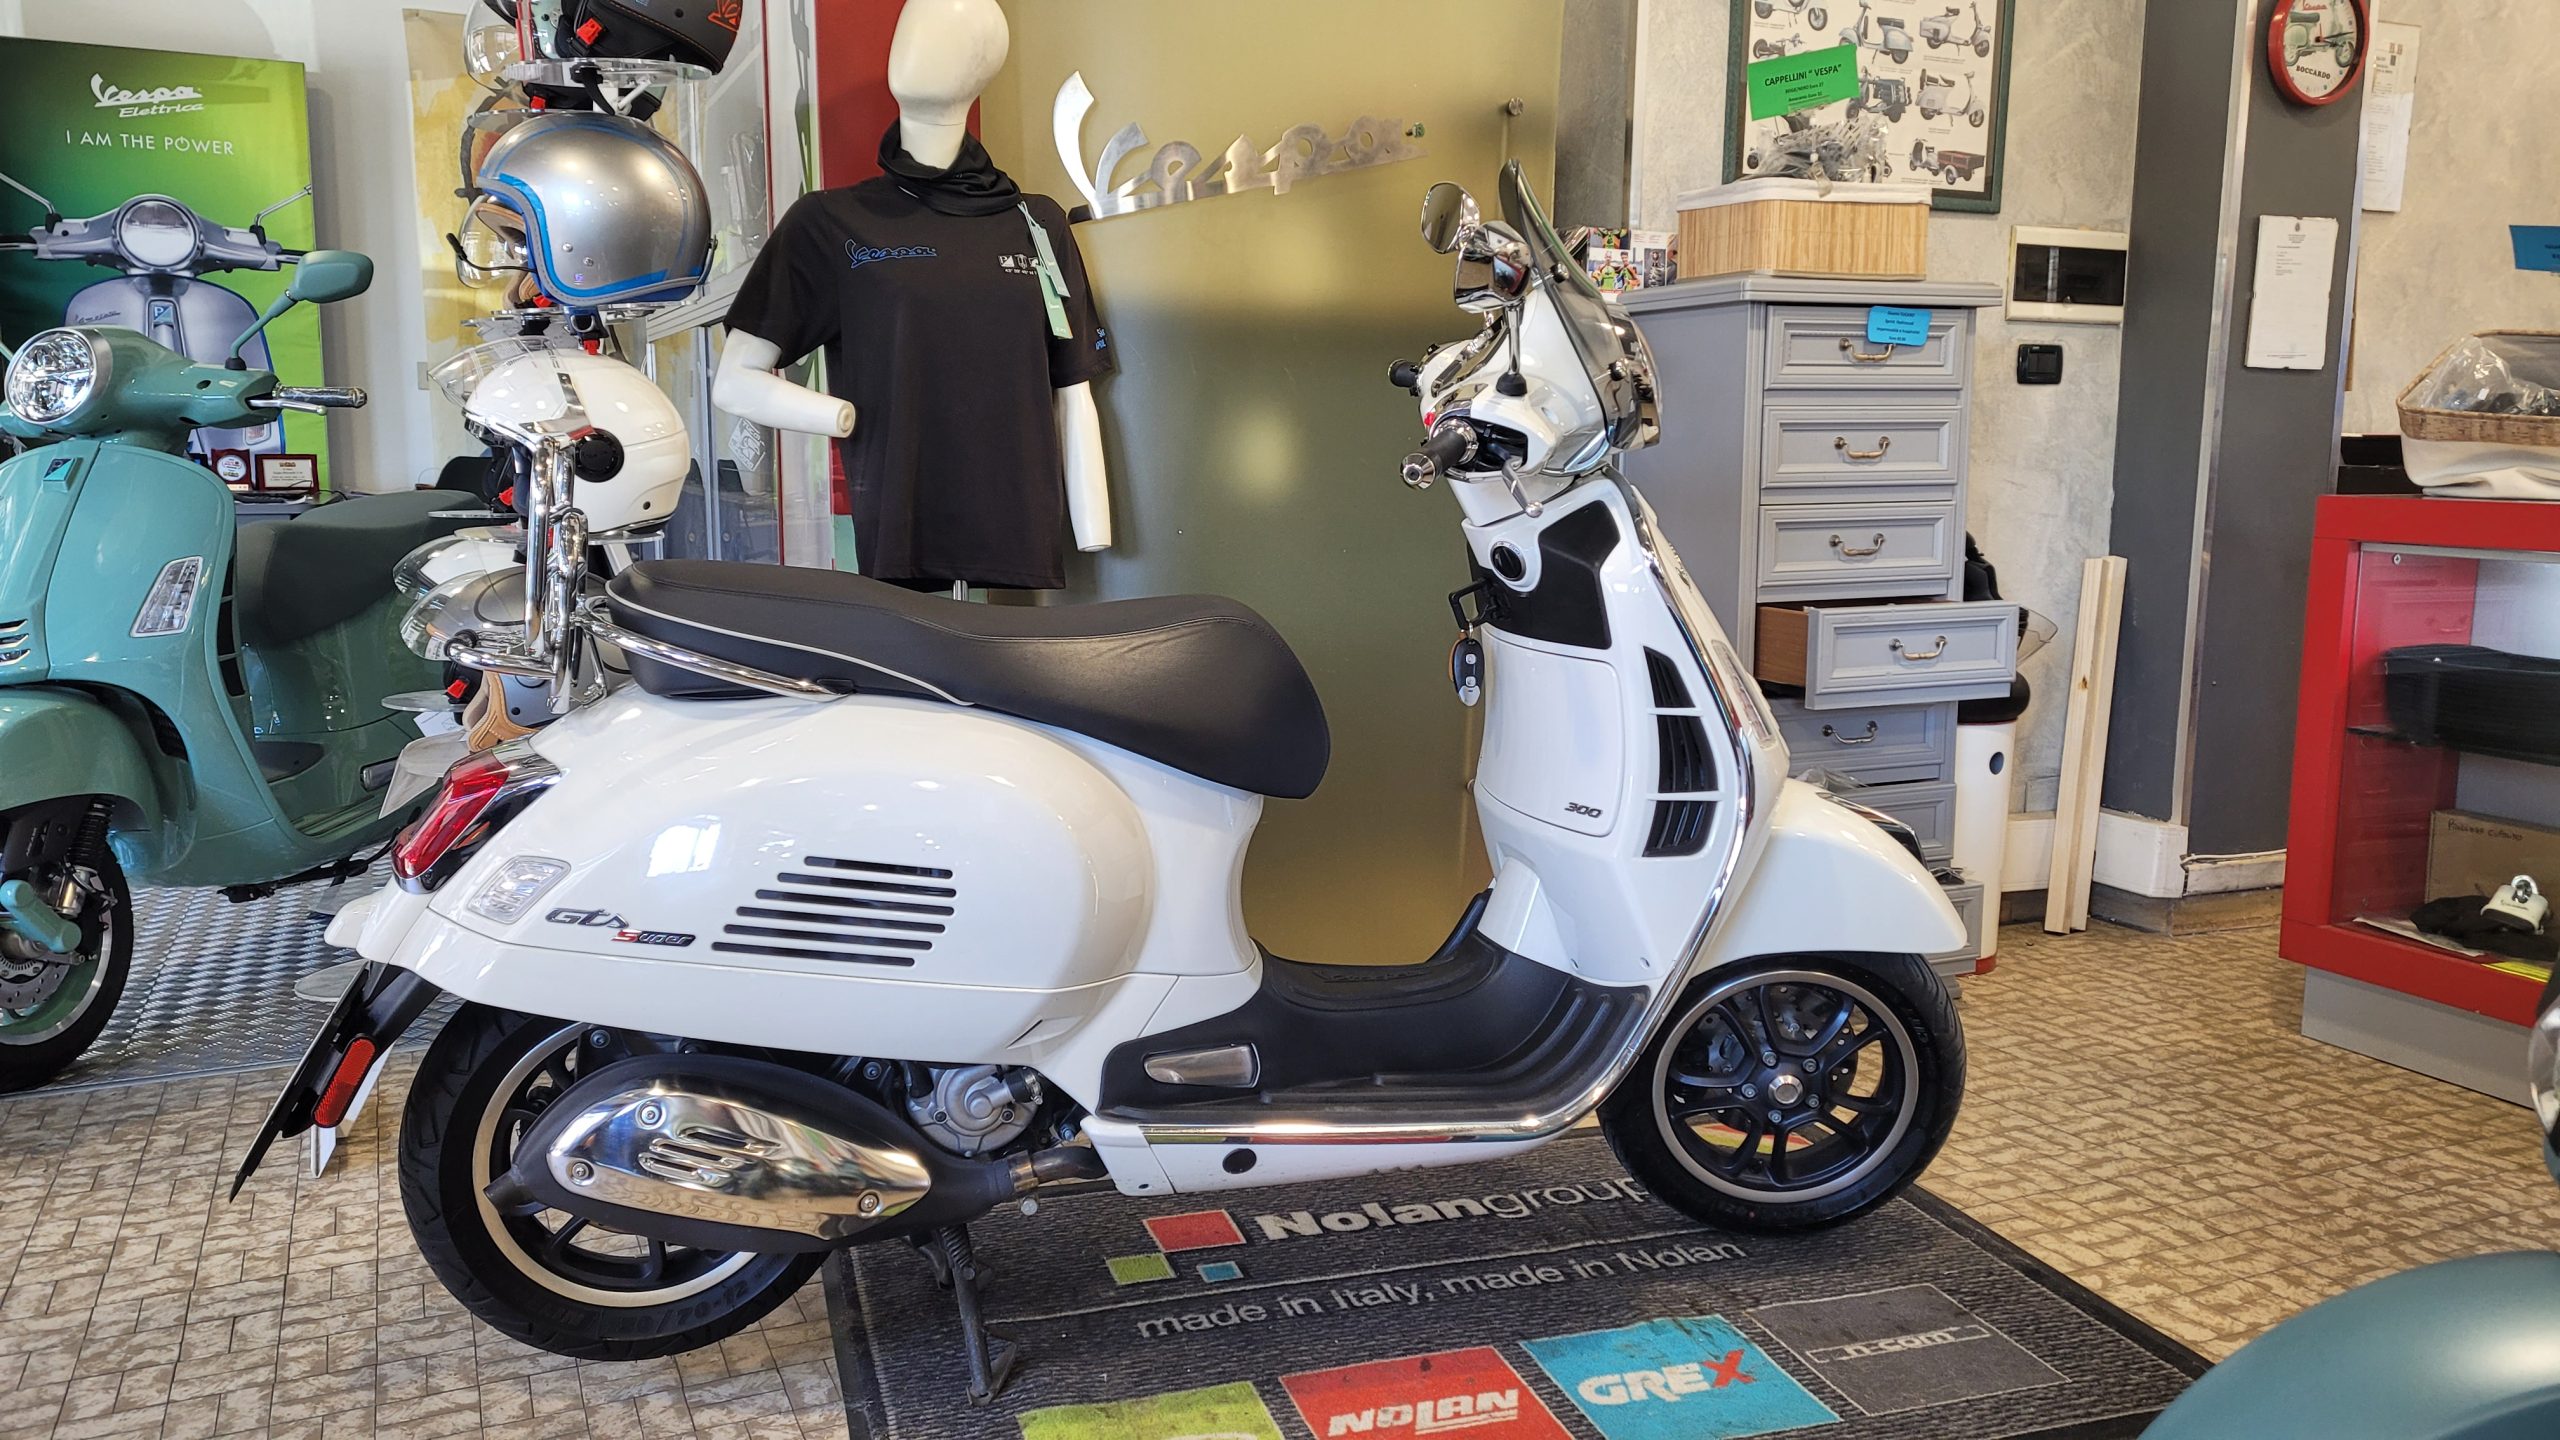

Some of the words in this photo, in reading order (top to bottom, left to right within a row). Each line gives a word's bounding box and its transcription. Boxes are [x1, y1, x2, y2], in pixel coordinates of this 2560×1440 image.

[1764, 71, 1807, 87] CAPPELLINI
[2296, 64, 2331, 80] BOCCARDO
[90, 73, 203, 108] Vespa
[119, 103, 205, 118] Elettrica
[66, 129, 71, 144] I
[80, 131, 112, 147] AM
[120, 133, 155, 150] THE
[164, 135, 234, 155] POWER
[1052, 70, 1428, 220] Vespa
[844, 238, 937, 269] Vespa
[1564, 802, 1603, 818] 300
[611, 929, 694, 946] Super
[1136, 1302, 1267, 1338] made
[1276, 1294, 1323, 1317] in
[1328, 1282, 1435, 1306] Italy,
[1442, 1264, 1565, 1294] made
[1571, 1257, 1614, 1279] in
[1615, 1242, 1747, 1273] Nolan
[1578, 1349, 1758, 1406] GREX
[1327, 1388, 1519, 1437] NOLAN
